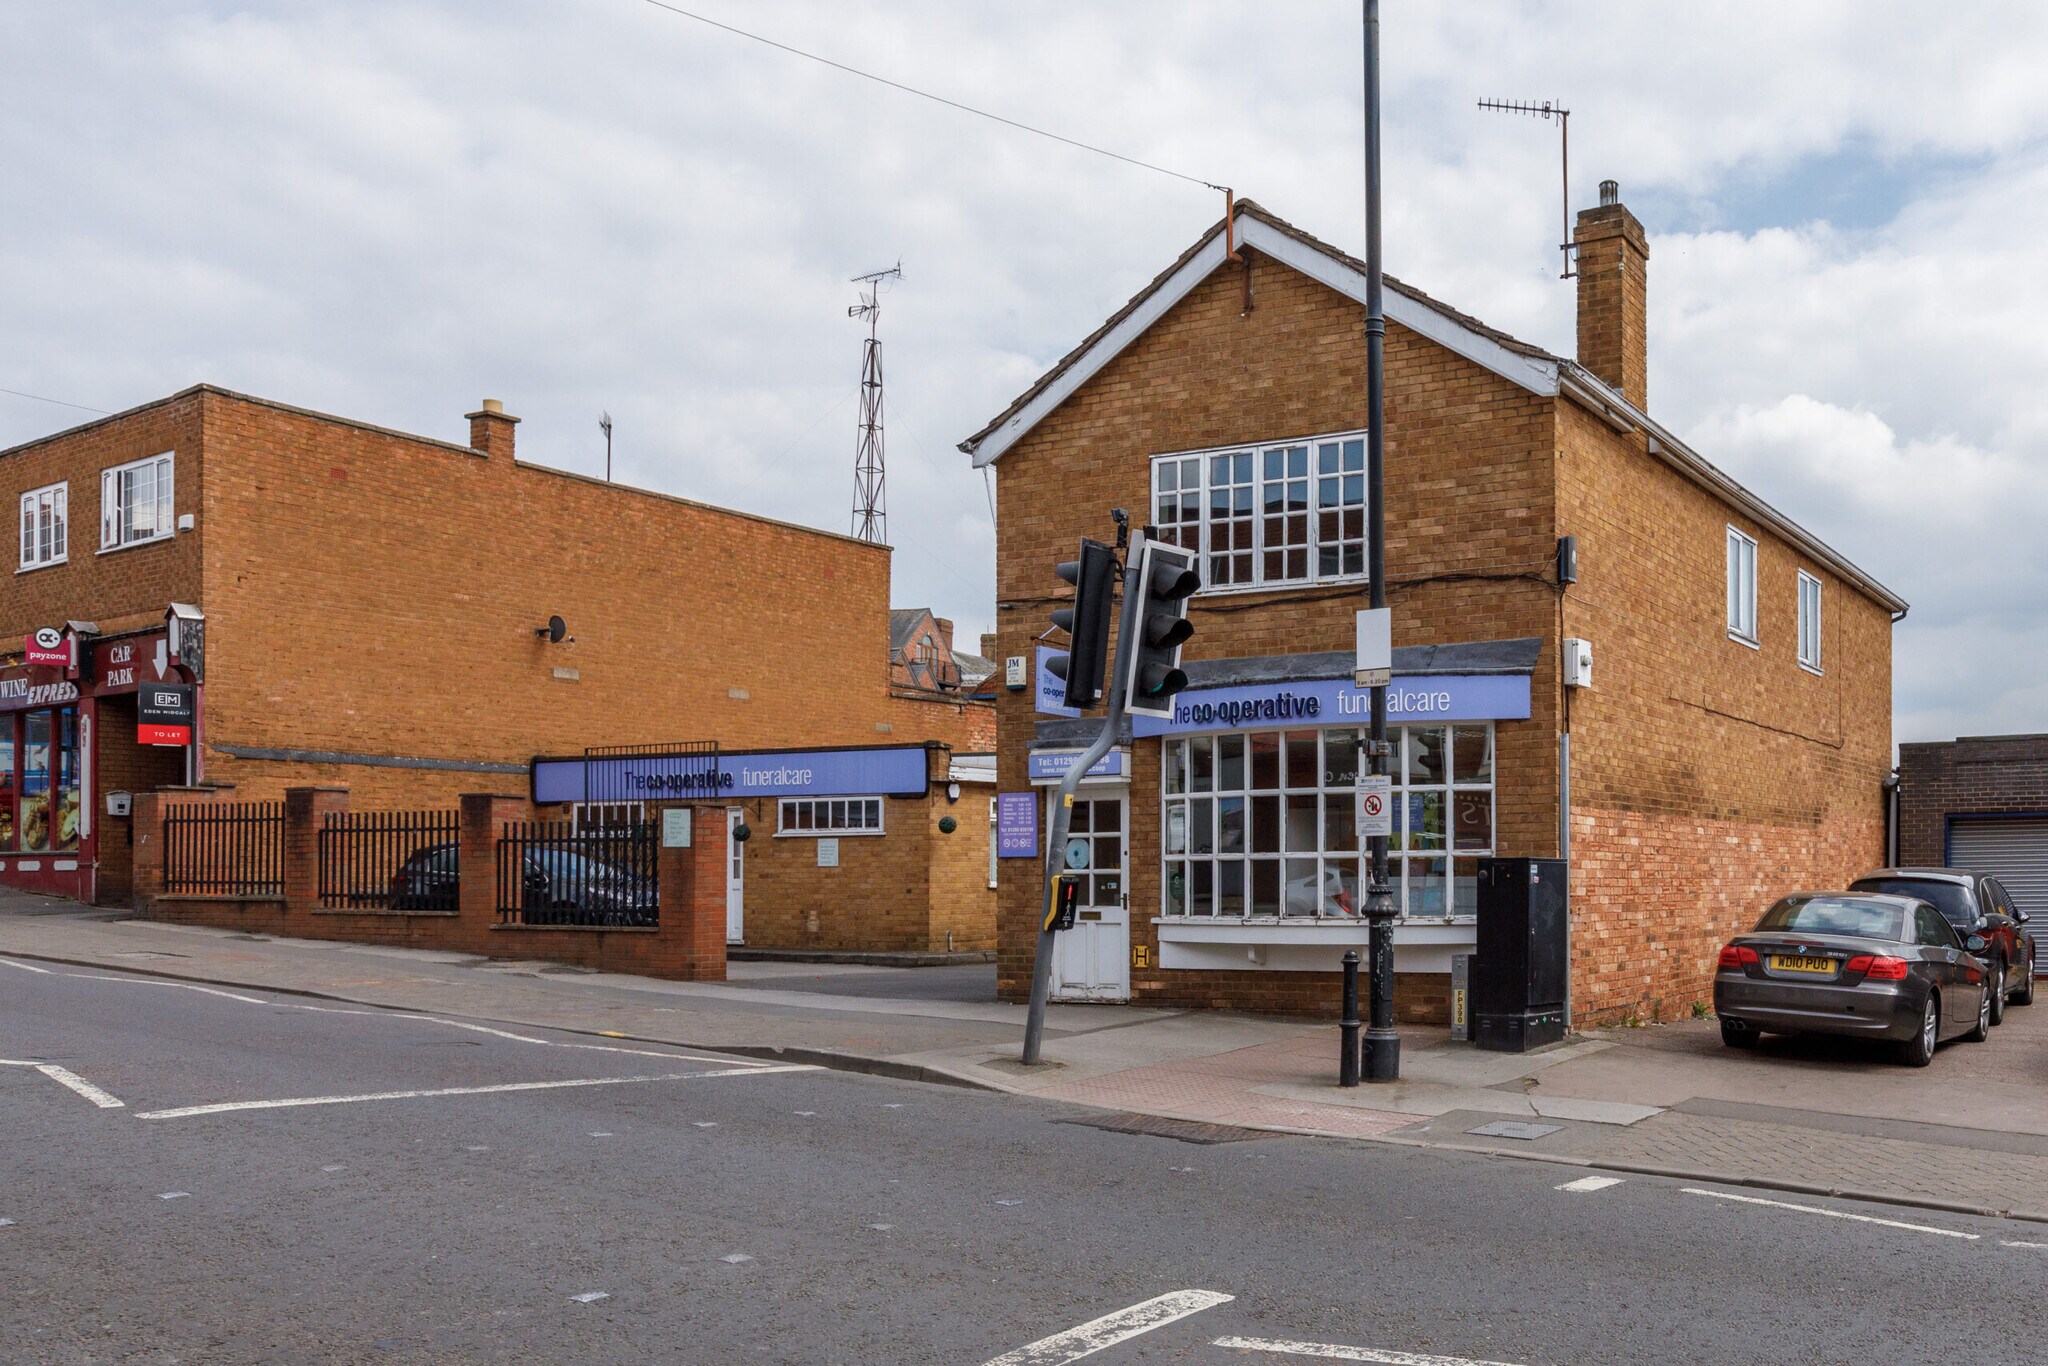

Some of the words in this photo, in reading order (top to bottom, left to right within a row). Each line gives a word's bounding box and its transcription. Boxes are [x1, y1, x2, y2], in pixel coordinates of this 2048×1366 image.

[29, 652, 67, 661] payzone
[111, 646, 131, 664] CAR
[1008, 659, 1020, 669] JM
[107, 668, 134, 687] PARK
[0, 678, 28, 699] WINE
[27, 682, 79, 705] EXPRESS
[1043, 687, 1065, 698] co-oper
[1170, 702, 1191, 725] he
[1337, 688, 1450, 714] funalcare
[1038, 758, 1052, 766] Tel:
[624, 771, 645, 790] The
[742, 766, 812, 786] funeralcare
